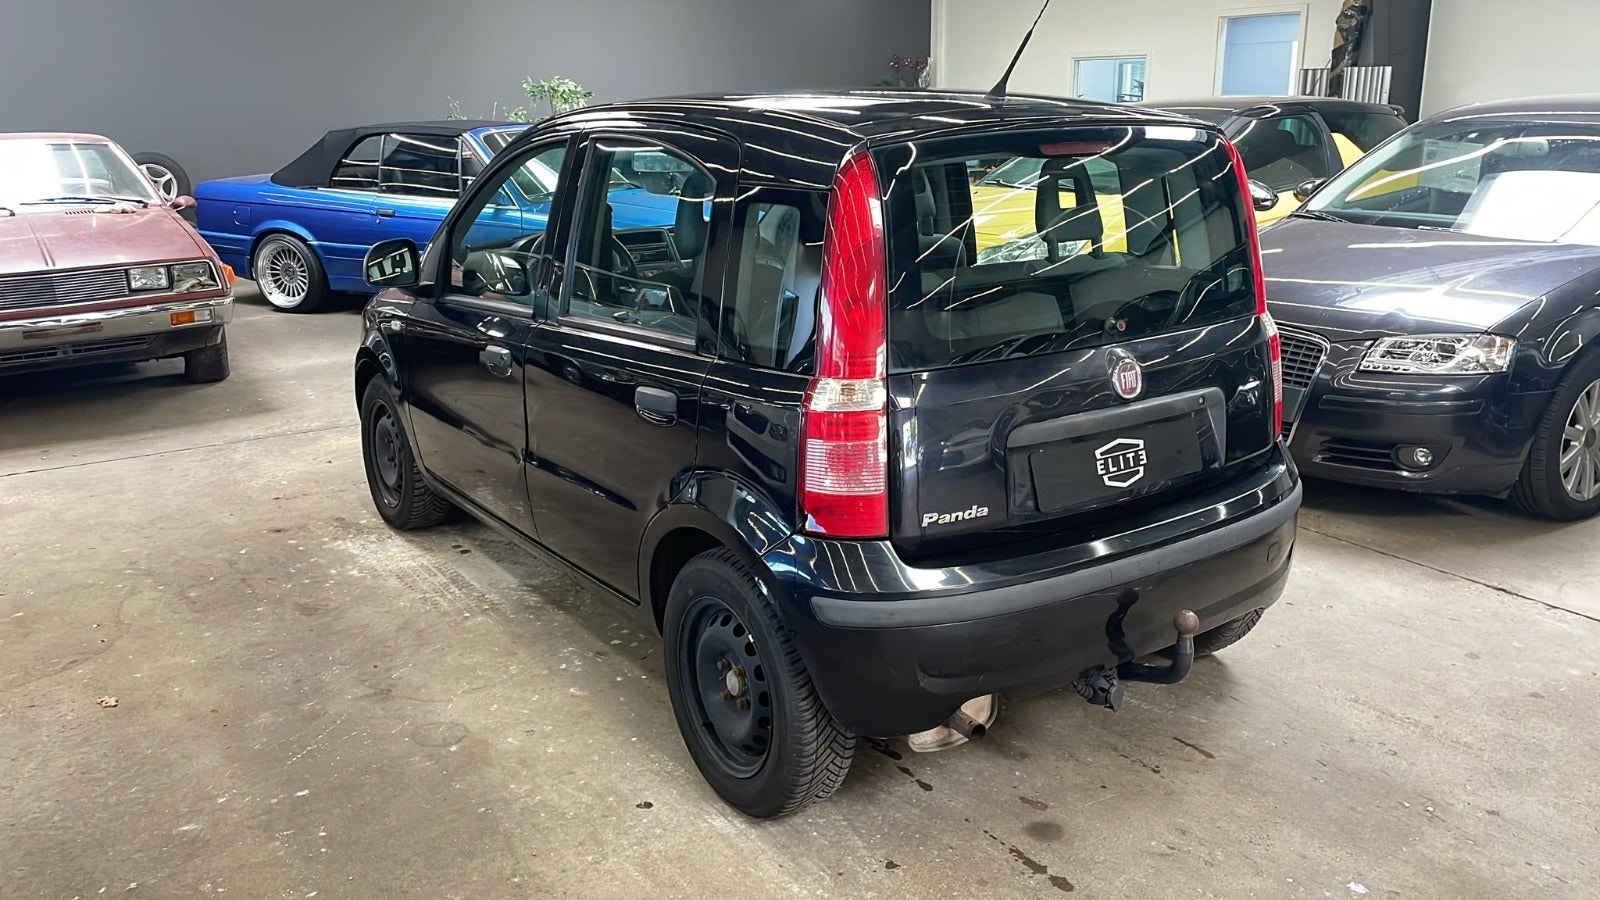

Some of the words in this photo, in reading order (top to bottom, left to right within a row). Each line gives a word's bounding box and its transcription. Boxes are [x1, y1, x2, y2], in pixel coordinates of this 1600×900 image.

[1120, 370, 1137, 390] FIAT
[1096, 450, 1147, 475] ELITE
[921, 504, 989, 527] Panda
